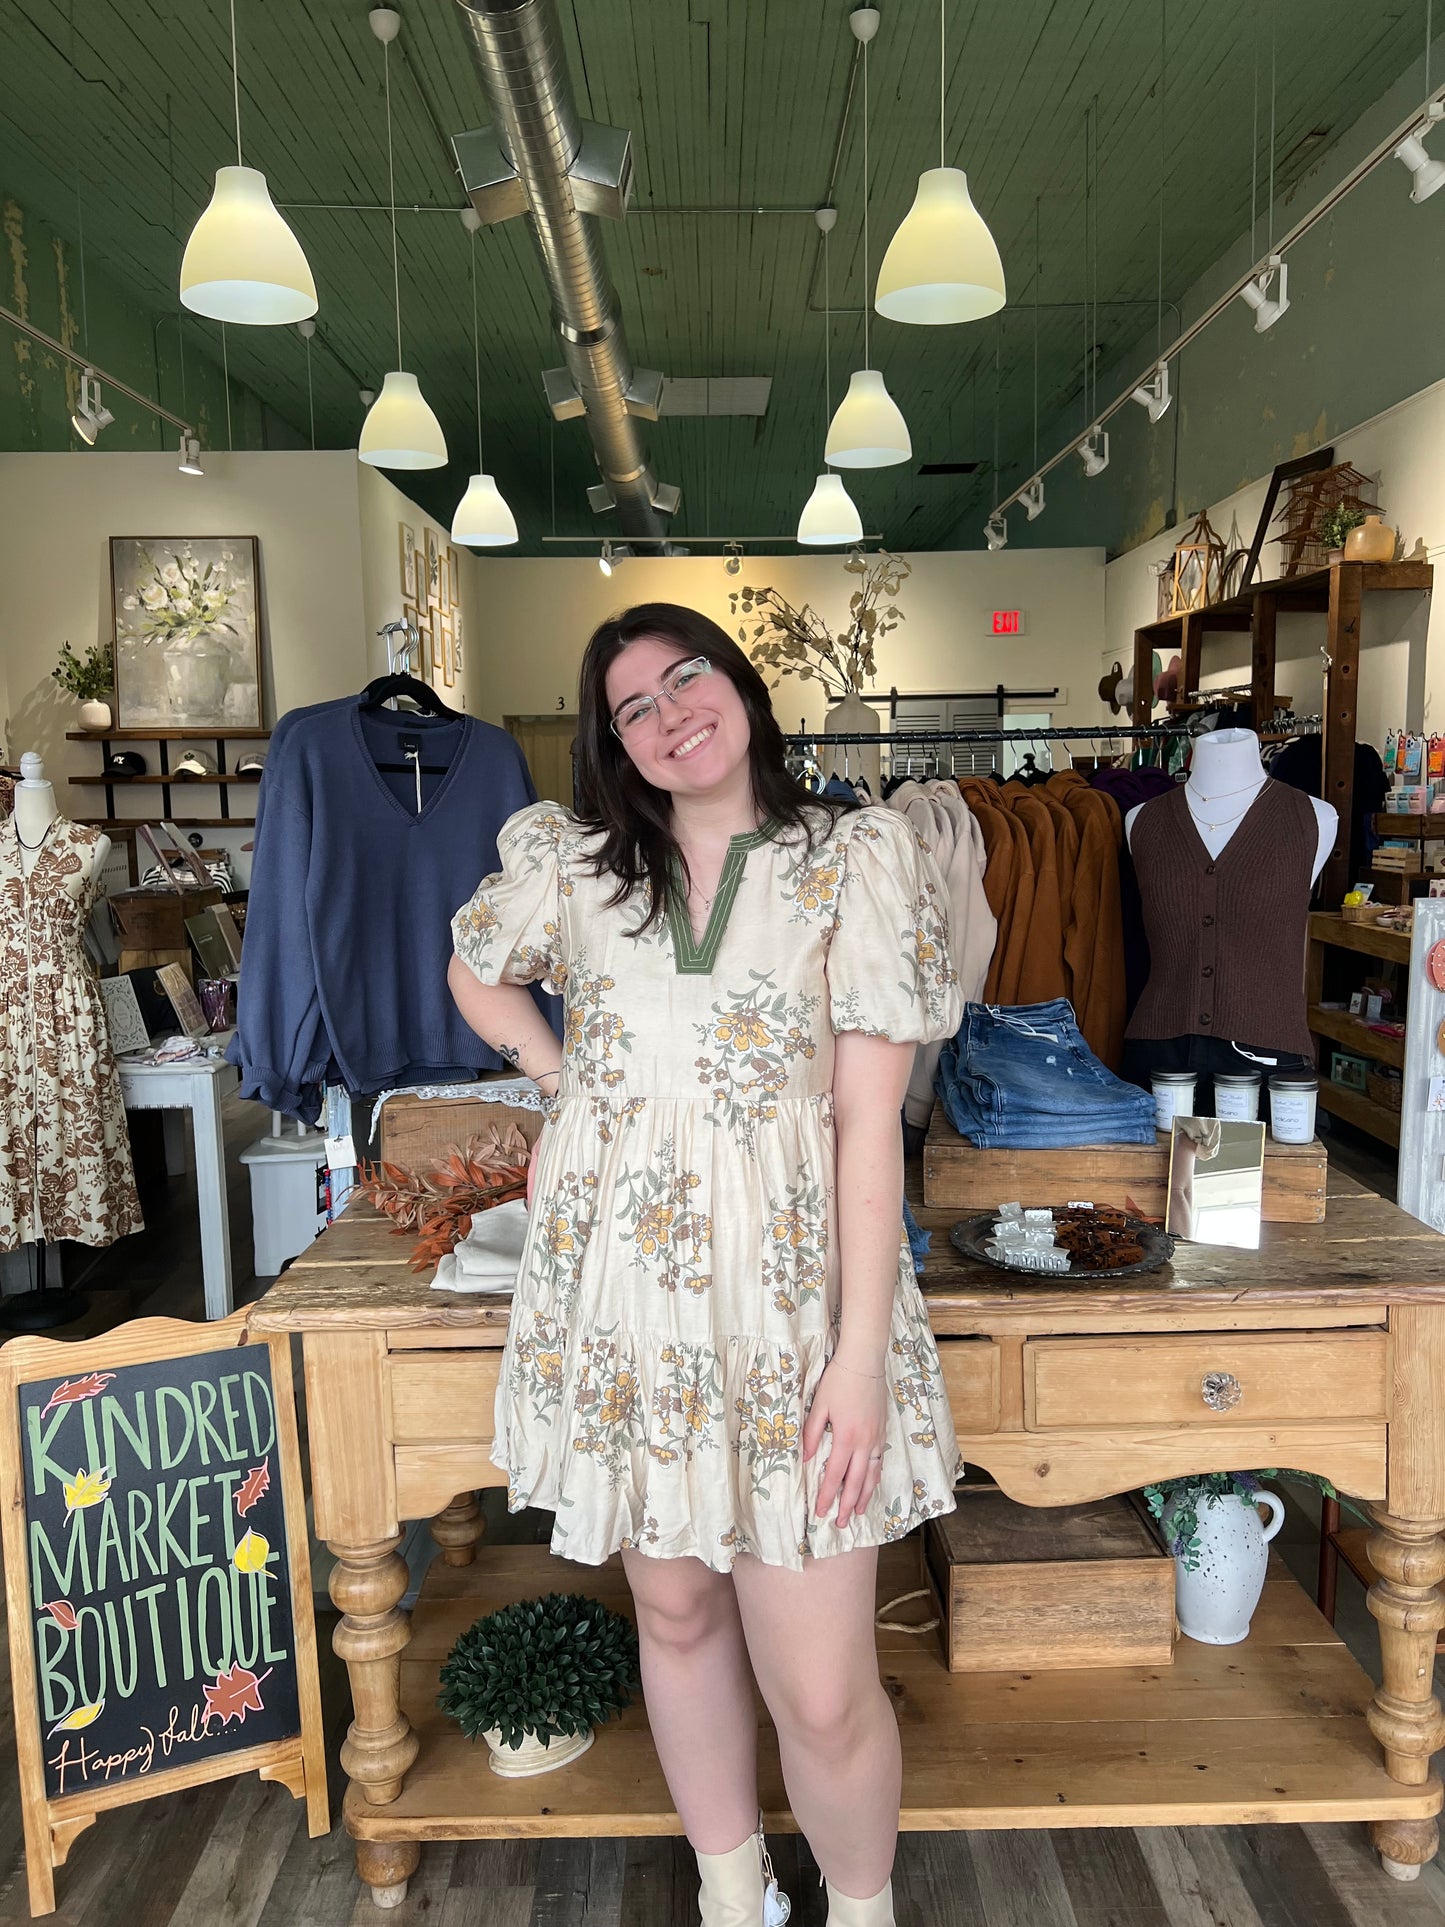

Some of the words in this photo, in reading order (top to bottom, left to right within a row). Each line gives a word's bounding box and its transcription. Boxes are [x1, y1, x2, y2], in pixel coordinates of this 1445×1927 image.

[993, 611, 1019, 633] EXIT
[555, 696, 565, 710] 3
[27, 1371, 275, 1495] KINDRED
[30, 1470, 244, 1607] MARKET
[36, 1551, 287, 1722] BOUTIQUE
[48, 1727, 154, 1794] Happy
